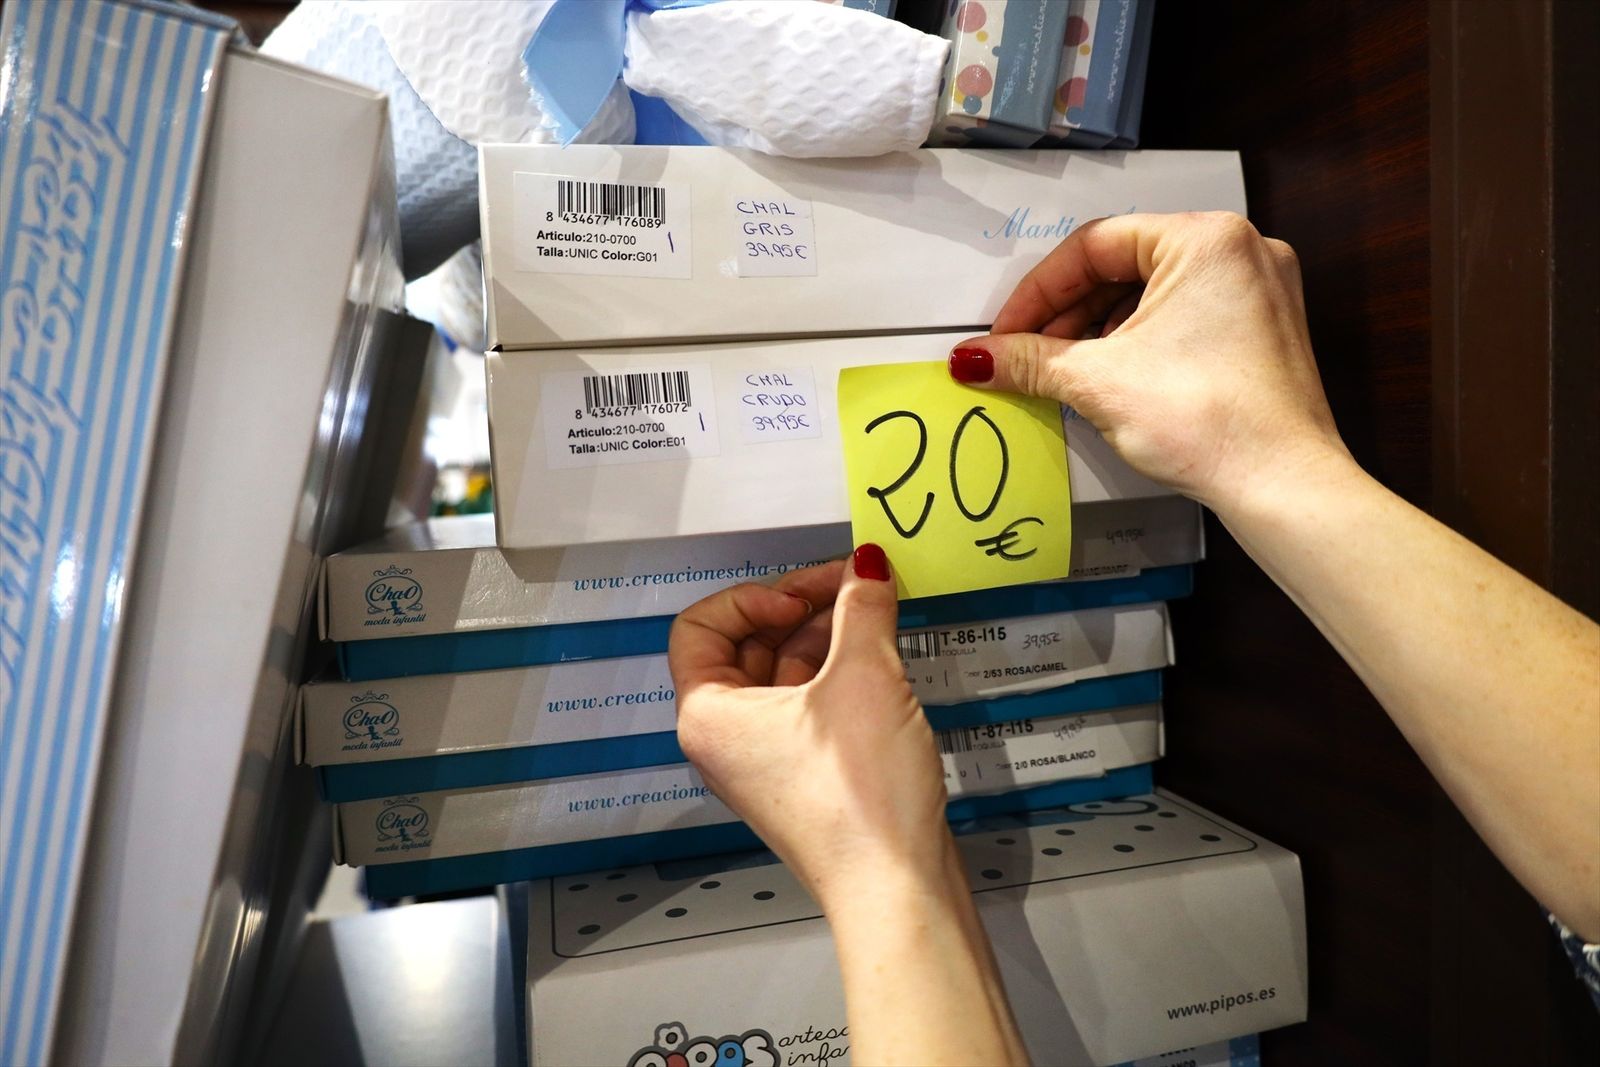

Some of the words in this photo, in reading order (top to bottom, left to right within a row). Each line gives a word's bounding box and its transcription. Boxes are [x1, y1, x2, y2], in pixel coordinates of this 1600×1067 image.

[563, 212, 610, 227] 434677
[616, 214, 662, 229] 176089
[743, 222, 794, 236] GRIS
[983, 206, 1079, 240] Marti
[536, 230, 637, 246] Articulo:210-0700
[536, 246, 599, 260] Talla:UNIC
[601, 250, 658, 263] Color:G01
[742, 394, 807, 406] CRUDO
[591, 405, 637, 419] 434677
[643, 402, 688, 414] 176072
[568, 422, 665, 439] Articulo:210-0700
[569, 440, 629, 455] Talla:UNIC
[632, 436, 686, 450] Color:E01
[864, 405, 1010, 539] 20
[974, 516, 1045, 561] €
[364, 617, 391, 627] moda
[392, 613, 427, 627] infantil
[1004, 662, 1067, 678] ROSA/CAMEL
[547, 685, 675, 713] www.creacio
[370, 738, 404, 751] infantil
[1030, 749, 1097, 768] ROSA/BLANCO
[568, 784, 713, 813] www.creacione
[1166, 986, 1277, 1020] www.pipos.es
